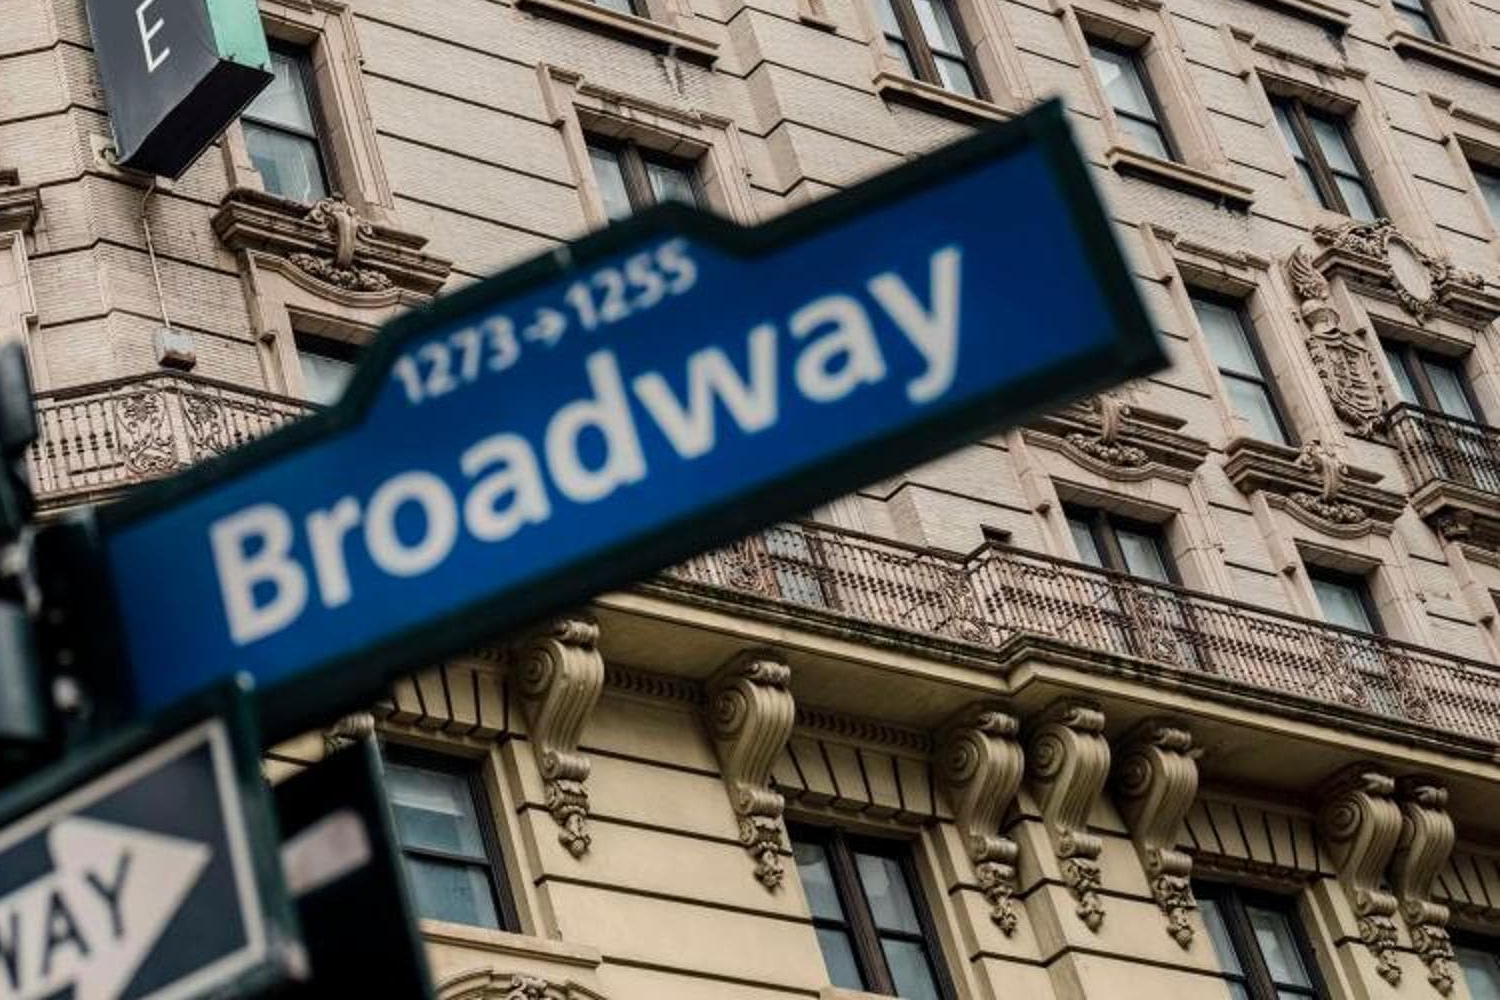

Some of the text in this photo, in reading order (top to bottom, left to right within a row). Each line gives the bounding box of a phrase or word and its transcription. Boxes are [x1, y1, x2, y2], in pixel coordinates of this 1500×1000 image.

[210, 246, 963, 647] Broadway
[392, 238, 697, 405] 1273 1255
